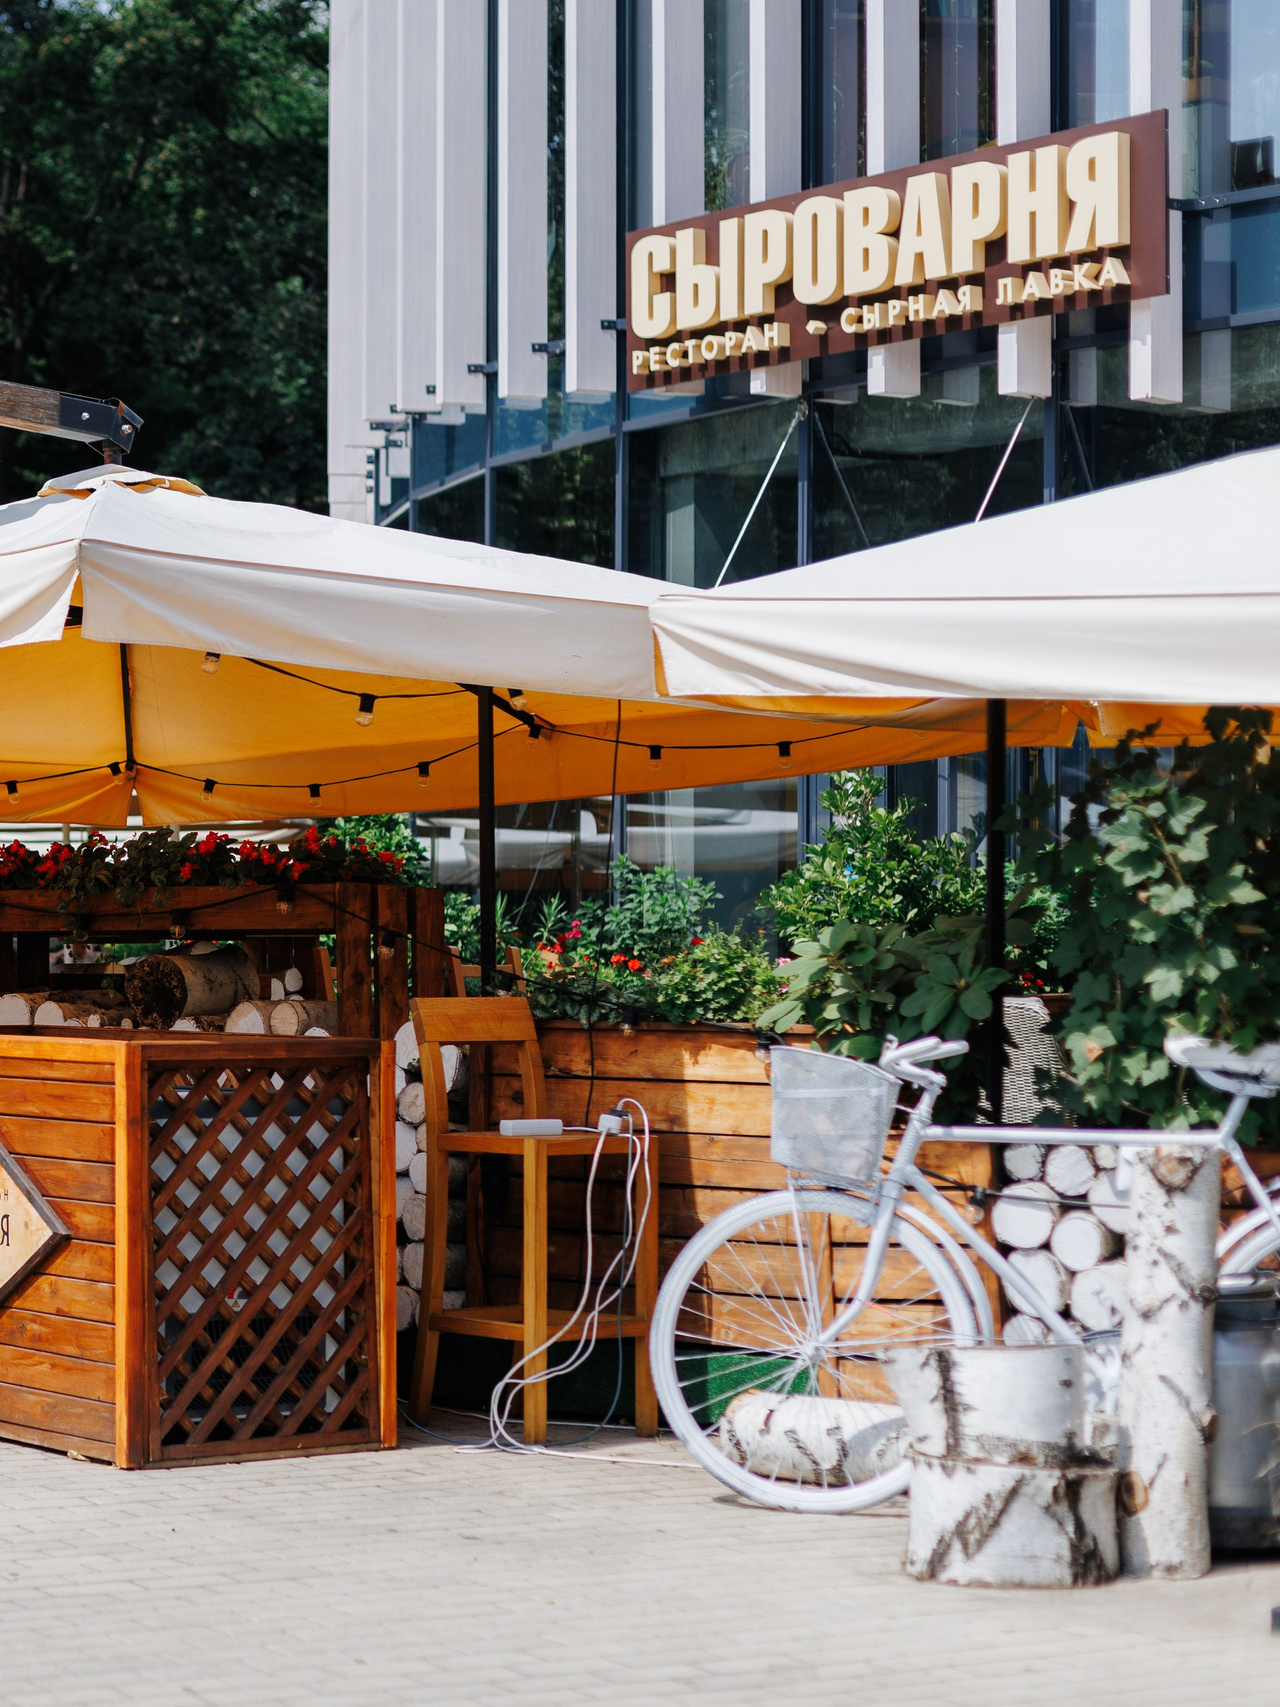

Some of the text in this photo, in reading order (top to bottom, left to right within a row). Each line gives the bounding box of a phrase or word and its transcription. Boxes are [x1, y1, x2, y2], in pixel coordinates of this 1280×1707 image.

[630, 131, 1131, 339] СЫРОВАРНЯ
[632, 256, 1131, 375] РЕСТОРАН СЫРНАЯ ЛАВКА
